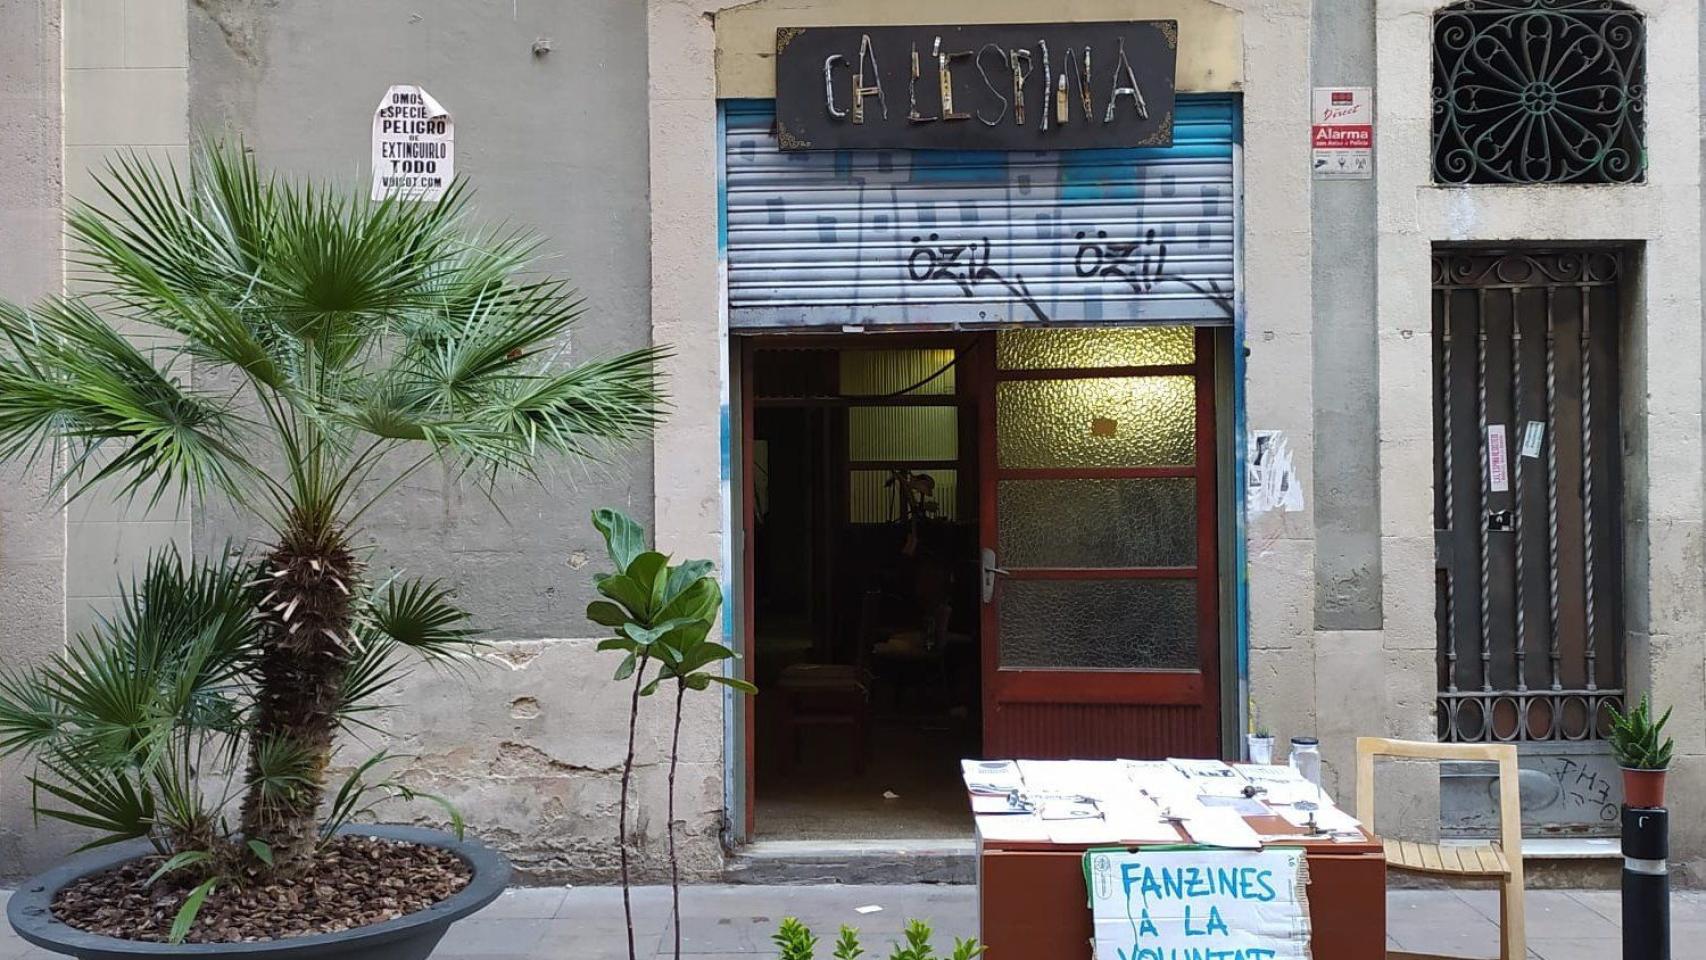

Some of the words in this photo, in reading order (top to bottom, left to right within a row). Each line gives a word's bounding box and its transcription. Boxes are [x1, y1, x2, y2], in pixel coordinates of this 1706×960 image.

[825, 34, 888, 125] CA
[392, 93, 424, 105] OMOS
[383, 120, 446, 134] PELIGRO
[1316, 127, 1368, 140] Alarma
[382, 142, 447, 159] EXTINGUIRLO
[391, 160, 436, 174] TODO
[1120, 863, 1276, 902] FANZINES
[1184, 904, 1229, 937] LA
